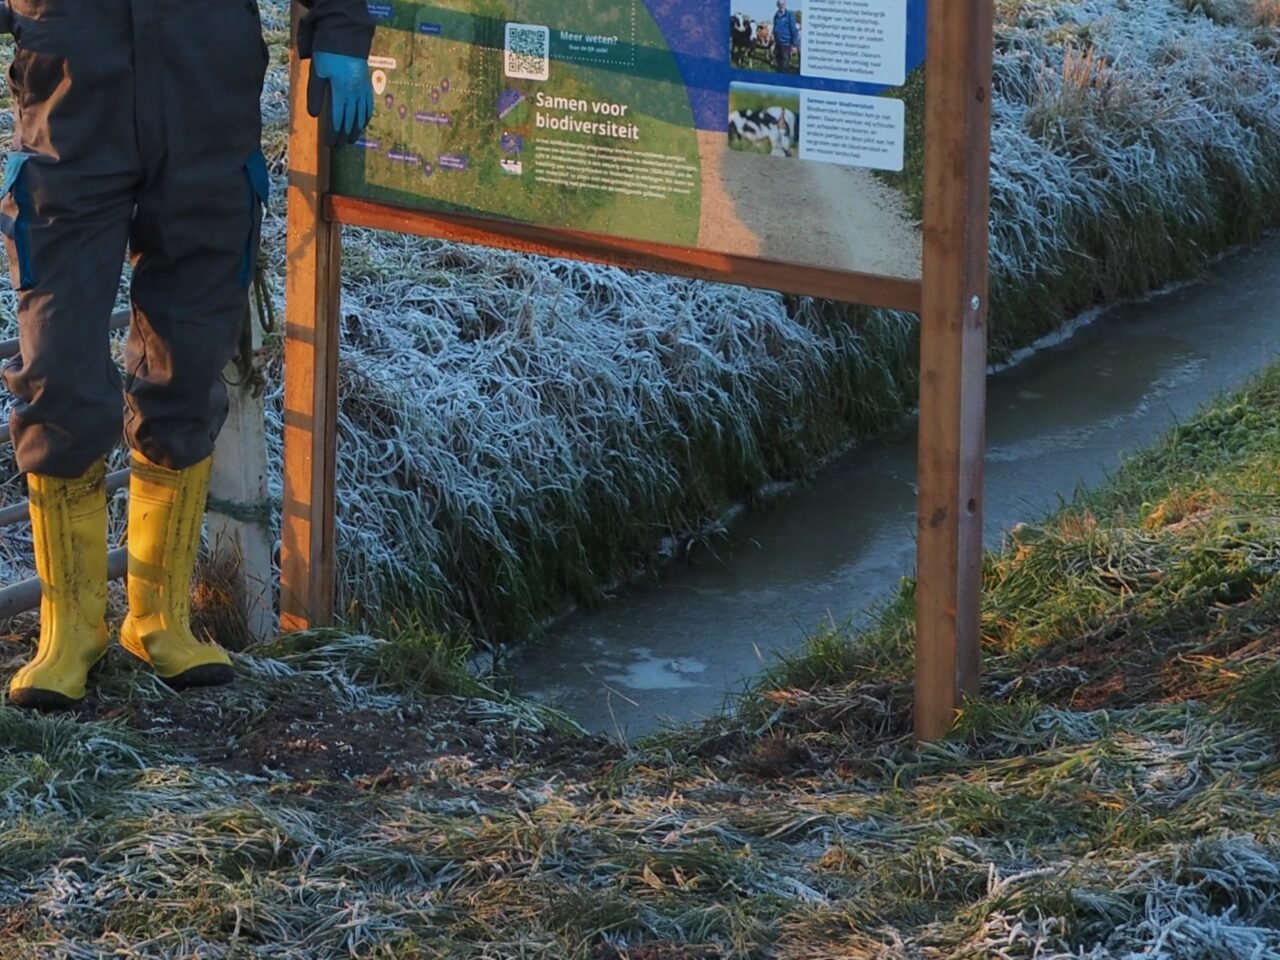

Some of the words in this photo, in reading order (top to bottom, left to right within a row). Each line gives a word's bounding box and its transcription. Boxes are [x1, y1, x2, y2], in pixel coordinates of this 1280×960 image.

[560, 30, 583, 42] Meer
[585, 33, 619, 45] weten?
[536, 92, 588, 112] Samen
[591, 102, 628, 116] voor
[536, 112, 640, 140] biodiversiteit
